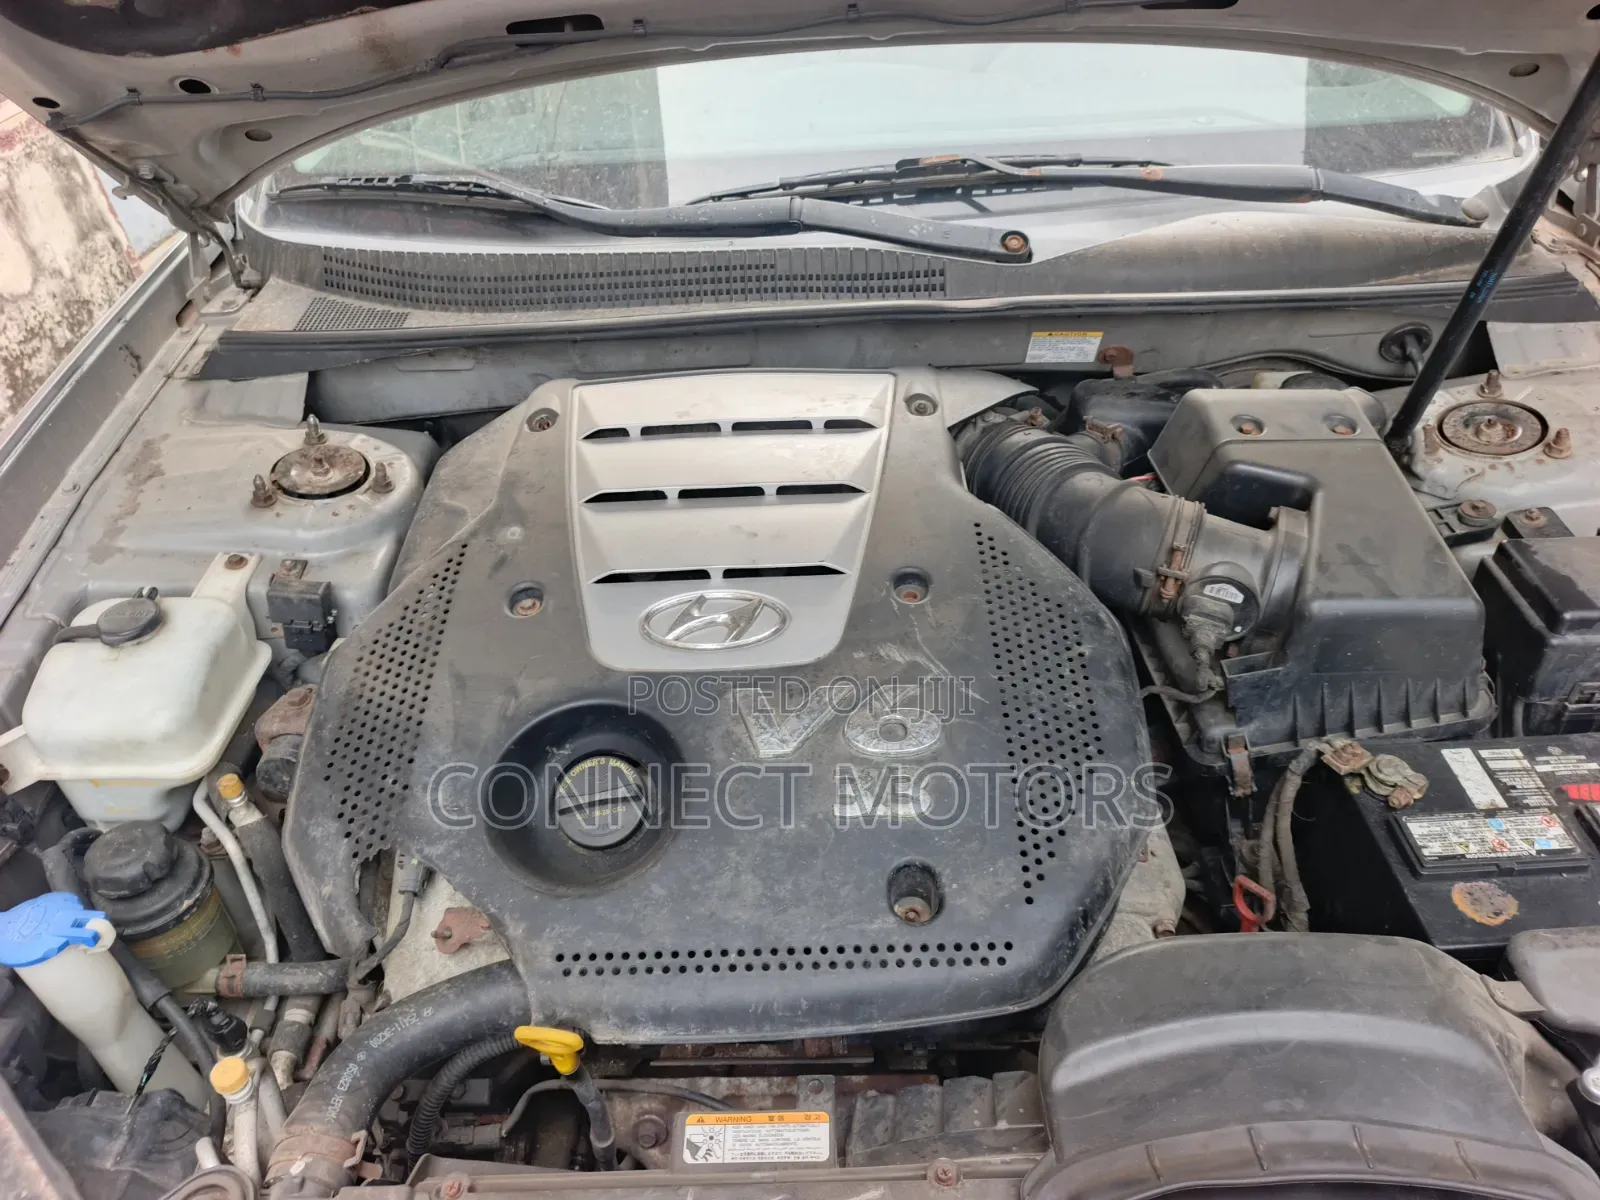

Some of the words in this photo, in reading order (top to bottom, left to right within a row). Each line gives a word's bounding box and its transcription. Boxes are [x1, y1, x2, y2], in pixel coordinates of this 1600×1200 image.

[731, 684, 942, 760] V6
[570, 757, 606, 777] OWNER'S
[608, 758, 638, 779] MANUAL
[715, 1115, 752, 1123] WARNING
